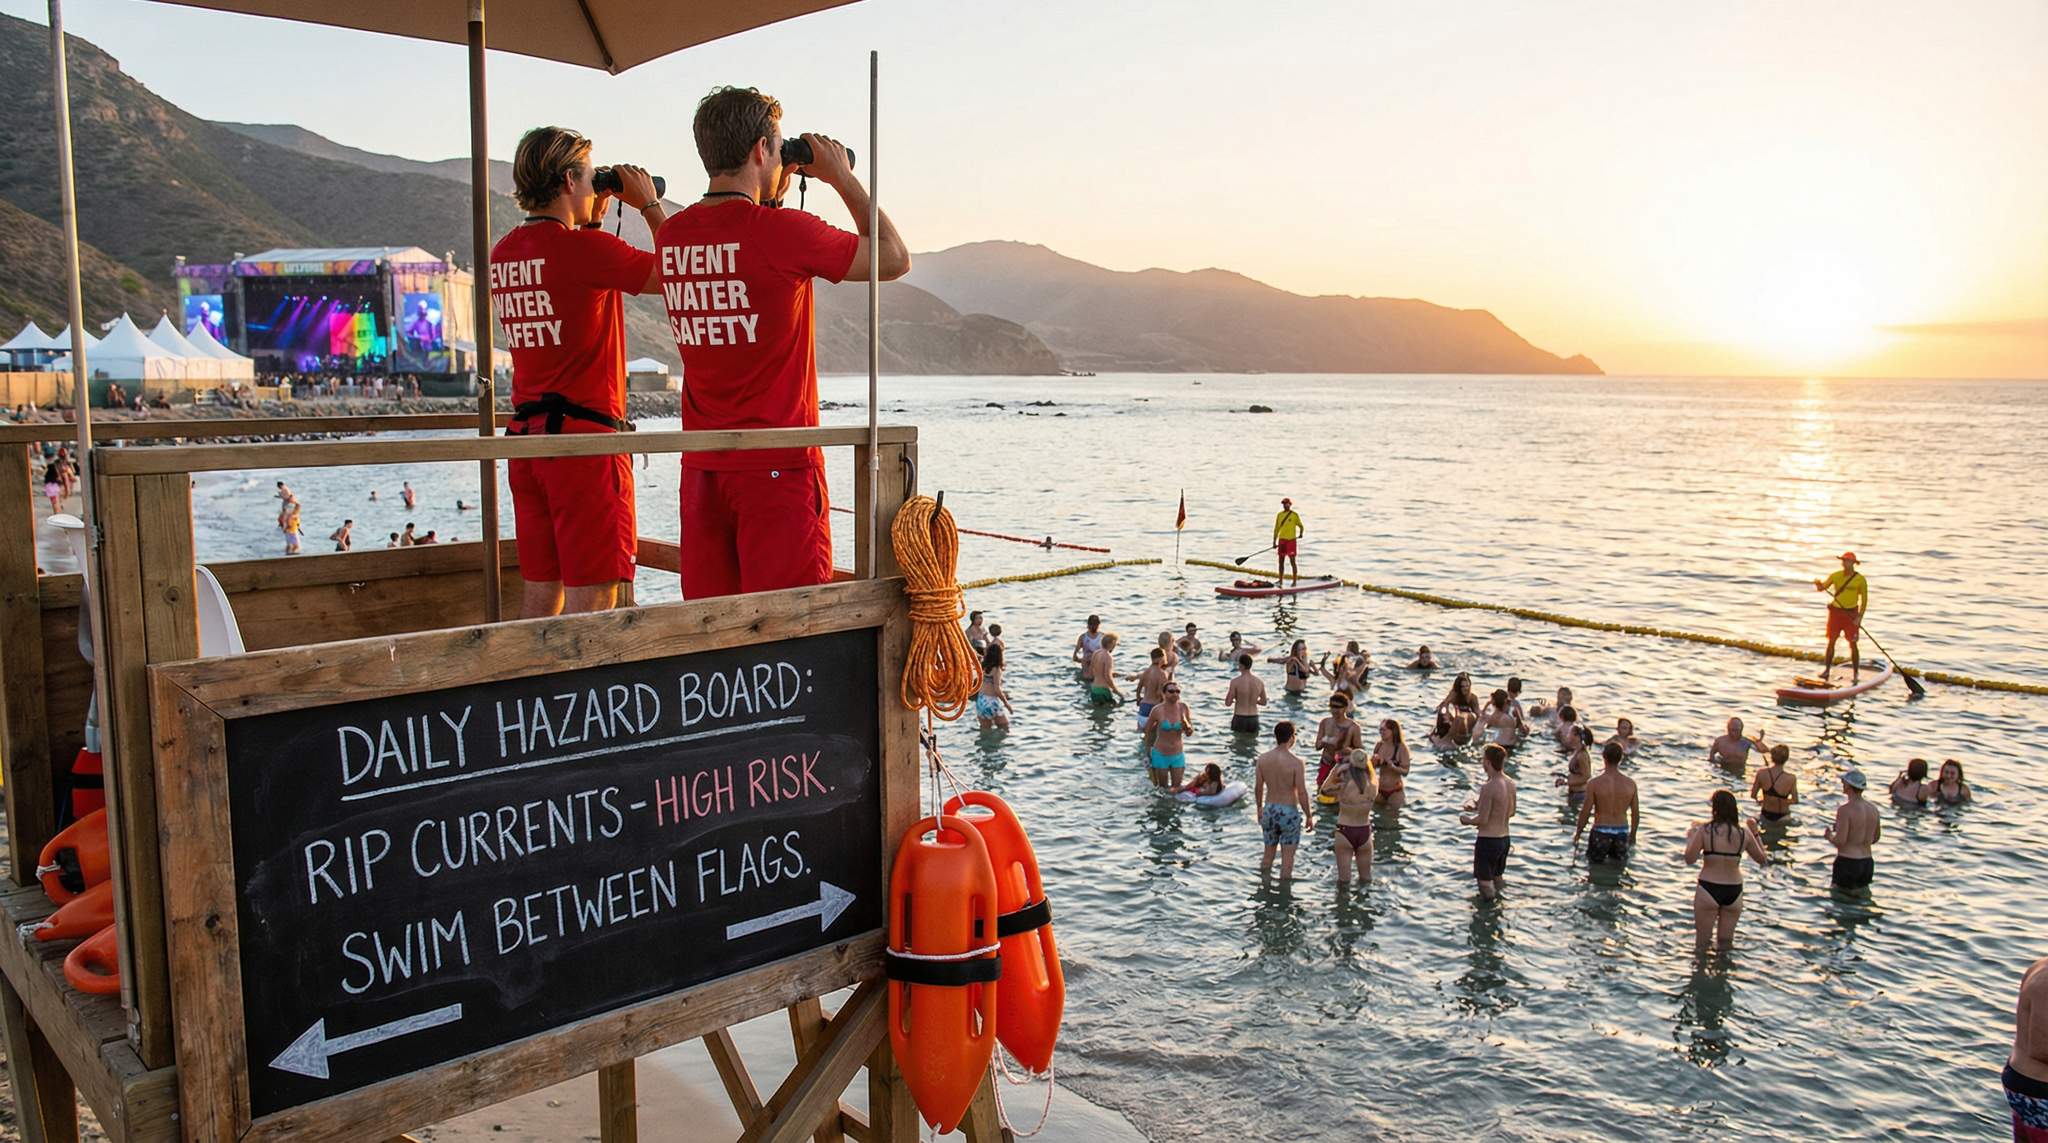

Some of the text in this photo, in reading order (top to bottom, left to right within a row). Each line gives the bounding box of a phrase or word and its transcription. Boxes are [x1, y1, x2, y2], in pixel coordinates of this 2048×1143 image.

[491, 259, 545, 289] EVENT
[662, 243, 740, 275] EVENT
[493, 291, 554, 318] WATER
[663, 280, 751, 310] WATER
[502, 320, 562, 348] AFETY
[670, 314, 759, 345] SAFETY
[337, 661, 813, 786] DAILY HAZARD BOARD:
[304, 829, 391, 904] RIP
[655, 766, 735, 827] HIGH
[749, 750, 836, 807] RISK.
[342, 830, 811, 994] SWIM BETWEEN FLAGS.
